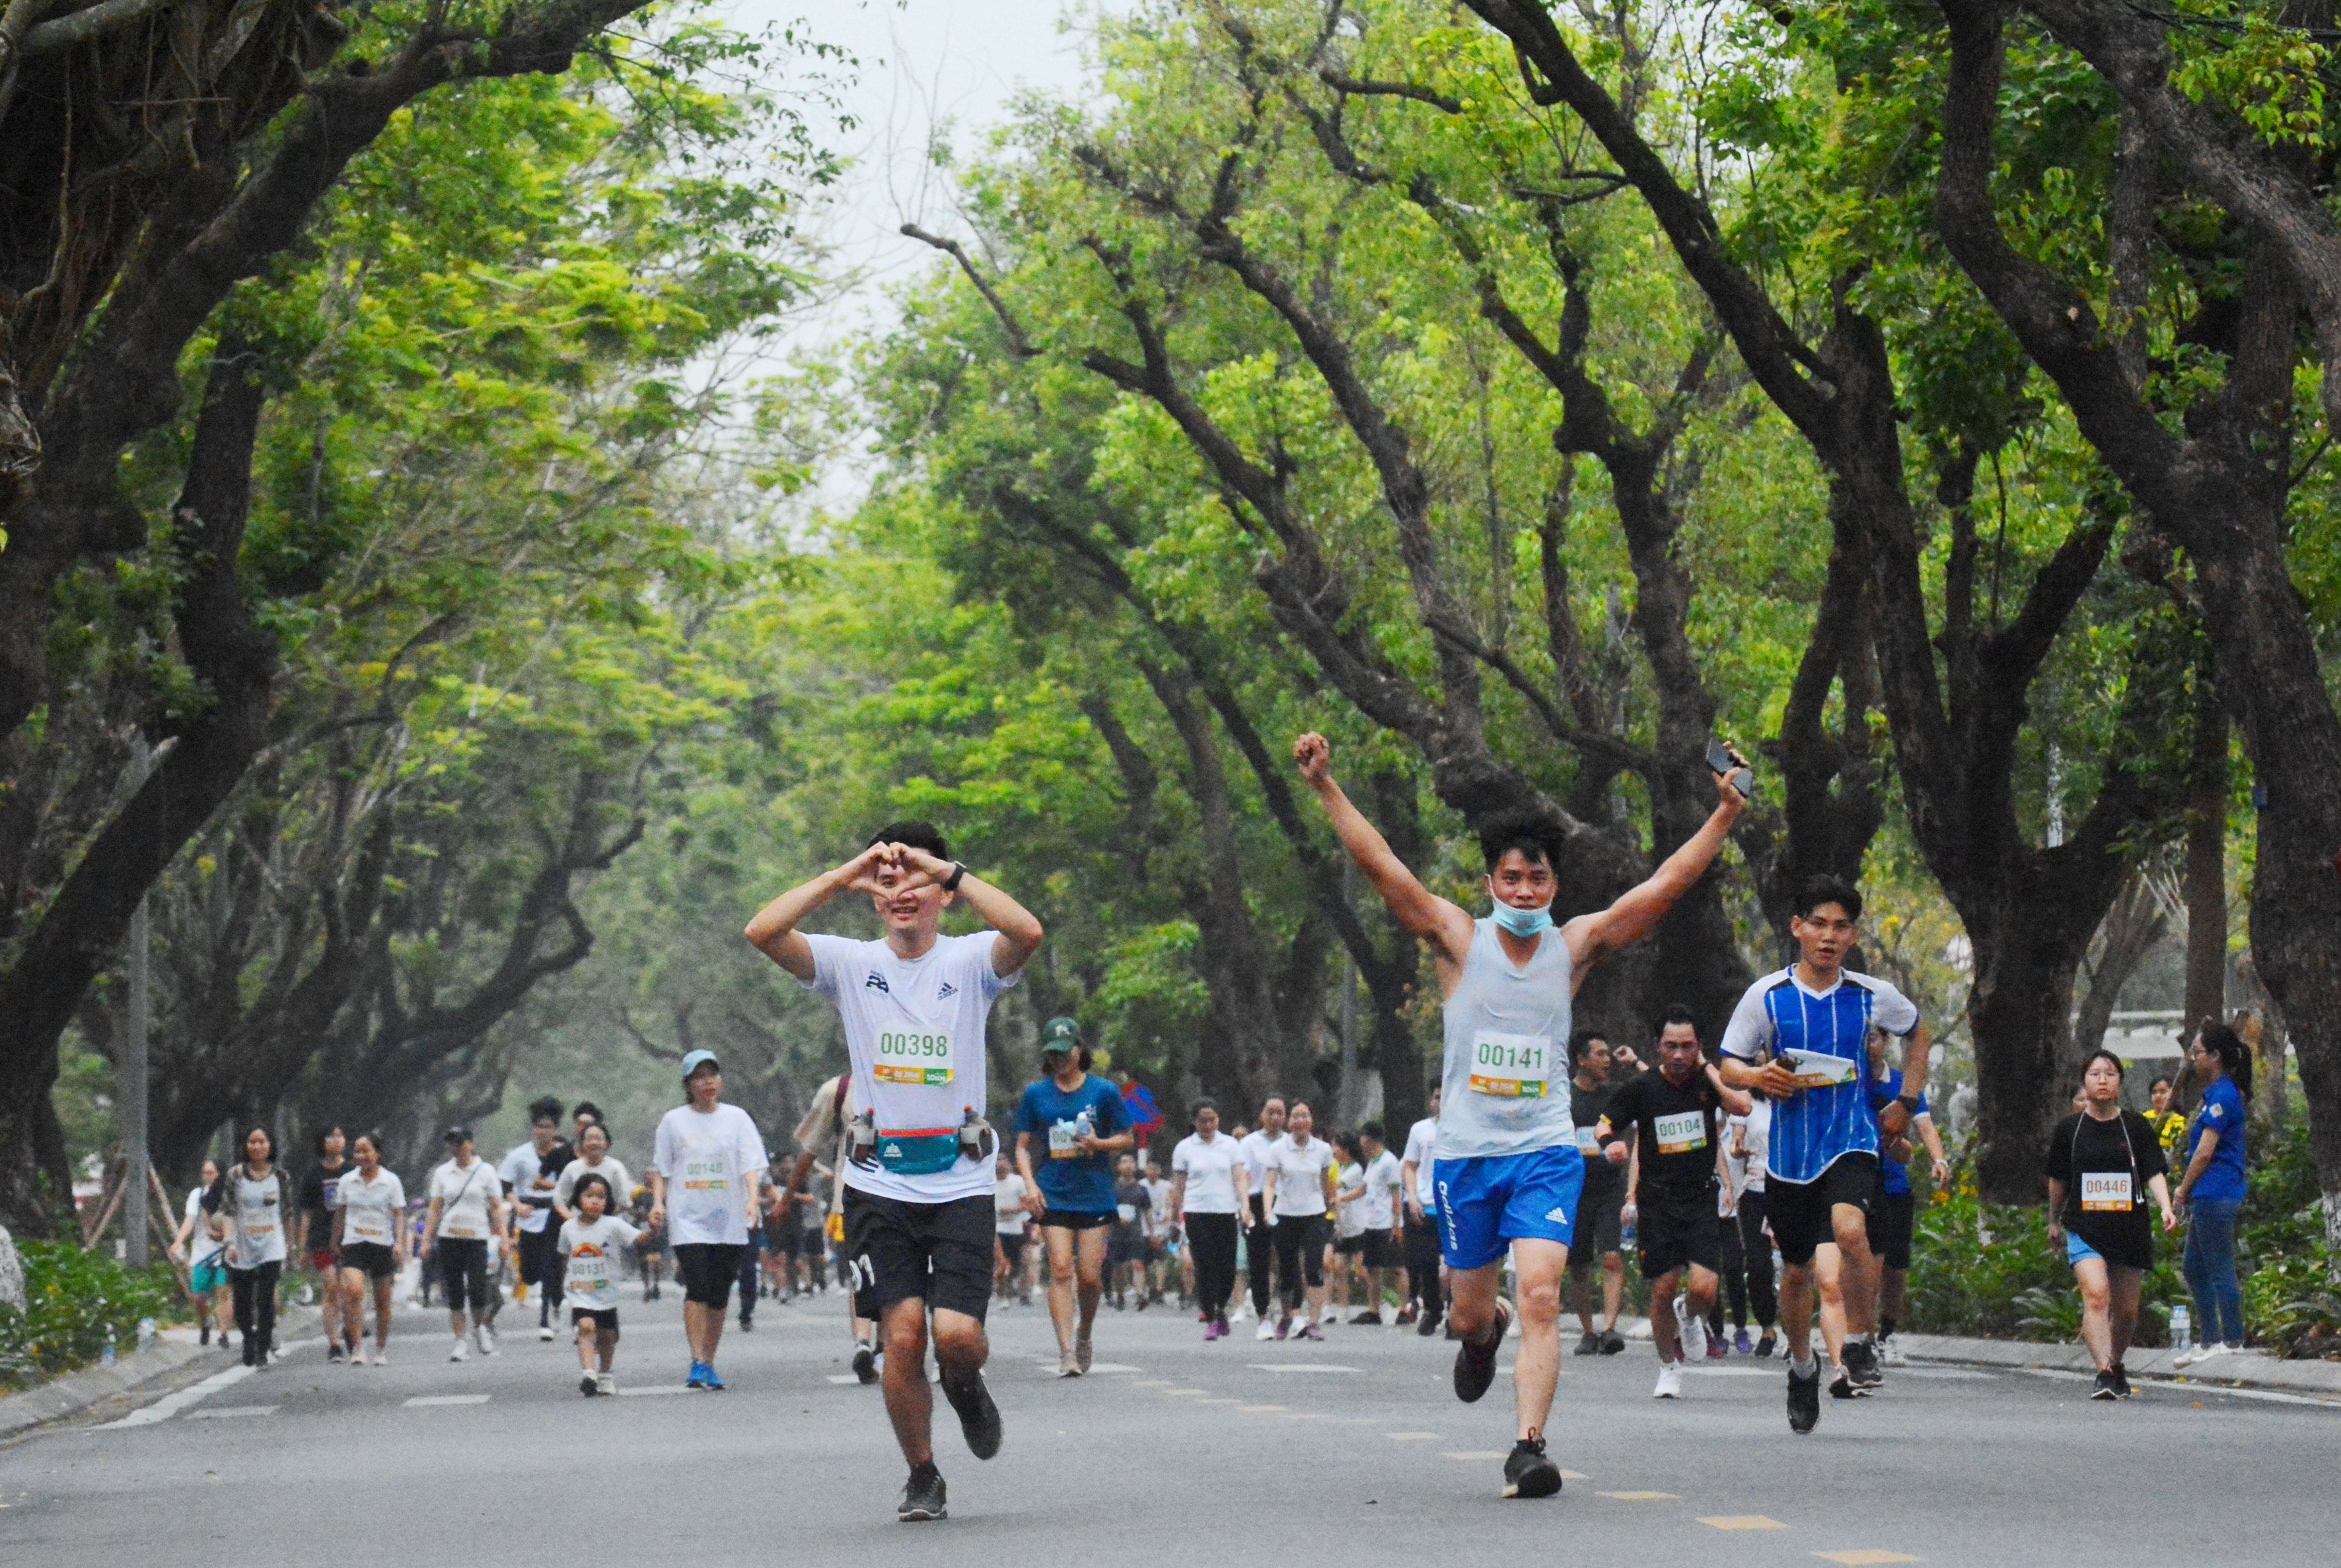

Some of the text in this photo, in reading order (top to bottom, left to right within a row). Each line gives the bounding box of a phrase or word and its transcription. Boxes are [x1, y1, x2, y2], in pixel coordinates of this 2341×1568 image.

[881, 1032, 947, 1057] 00398
[1478, 1044, 1542, 1069] 00141
[1659, 1118, 1700, 1137] 00104
[2086, 1180, 2128, 1194] 00446
[1438, 1180, 1459, 1251] adidas
